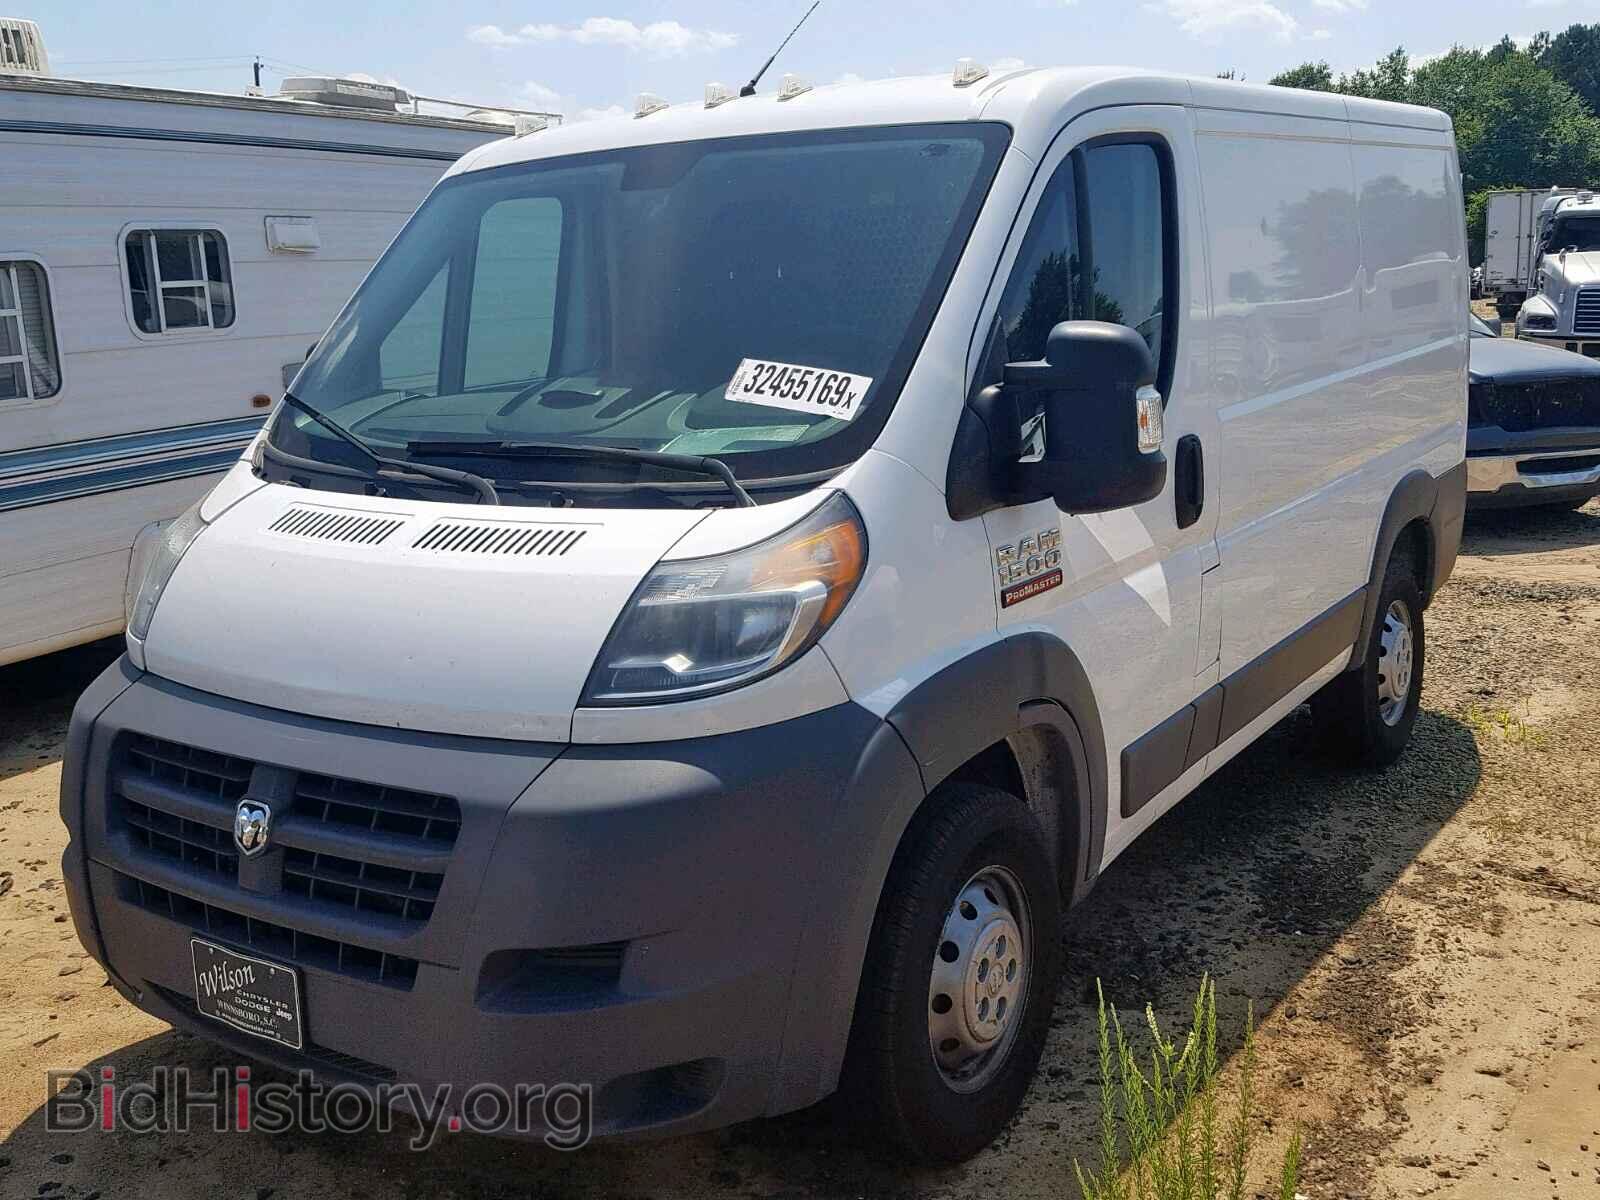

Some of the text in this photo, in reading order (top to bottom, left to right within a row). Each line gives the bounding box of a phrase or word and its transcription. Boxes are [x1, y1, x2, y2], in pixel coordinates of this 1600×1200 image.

[995, 528, 1062, 566] RAM
[998, 547, 1062, 587] 1500
[199, 960, 256, 997] Wilson
[234, 996, 293, 1021] DODGE Jeep
[236, 988, 289, 1010] CHRYSLER
